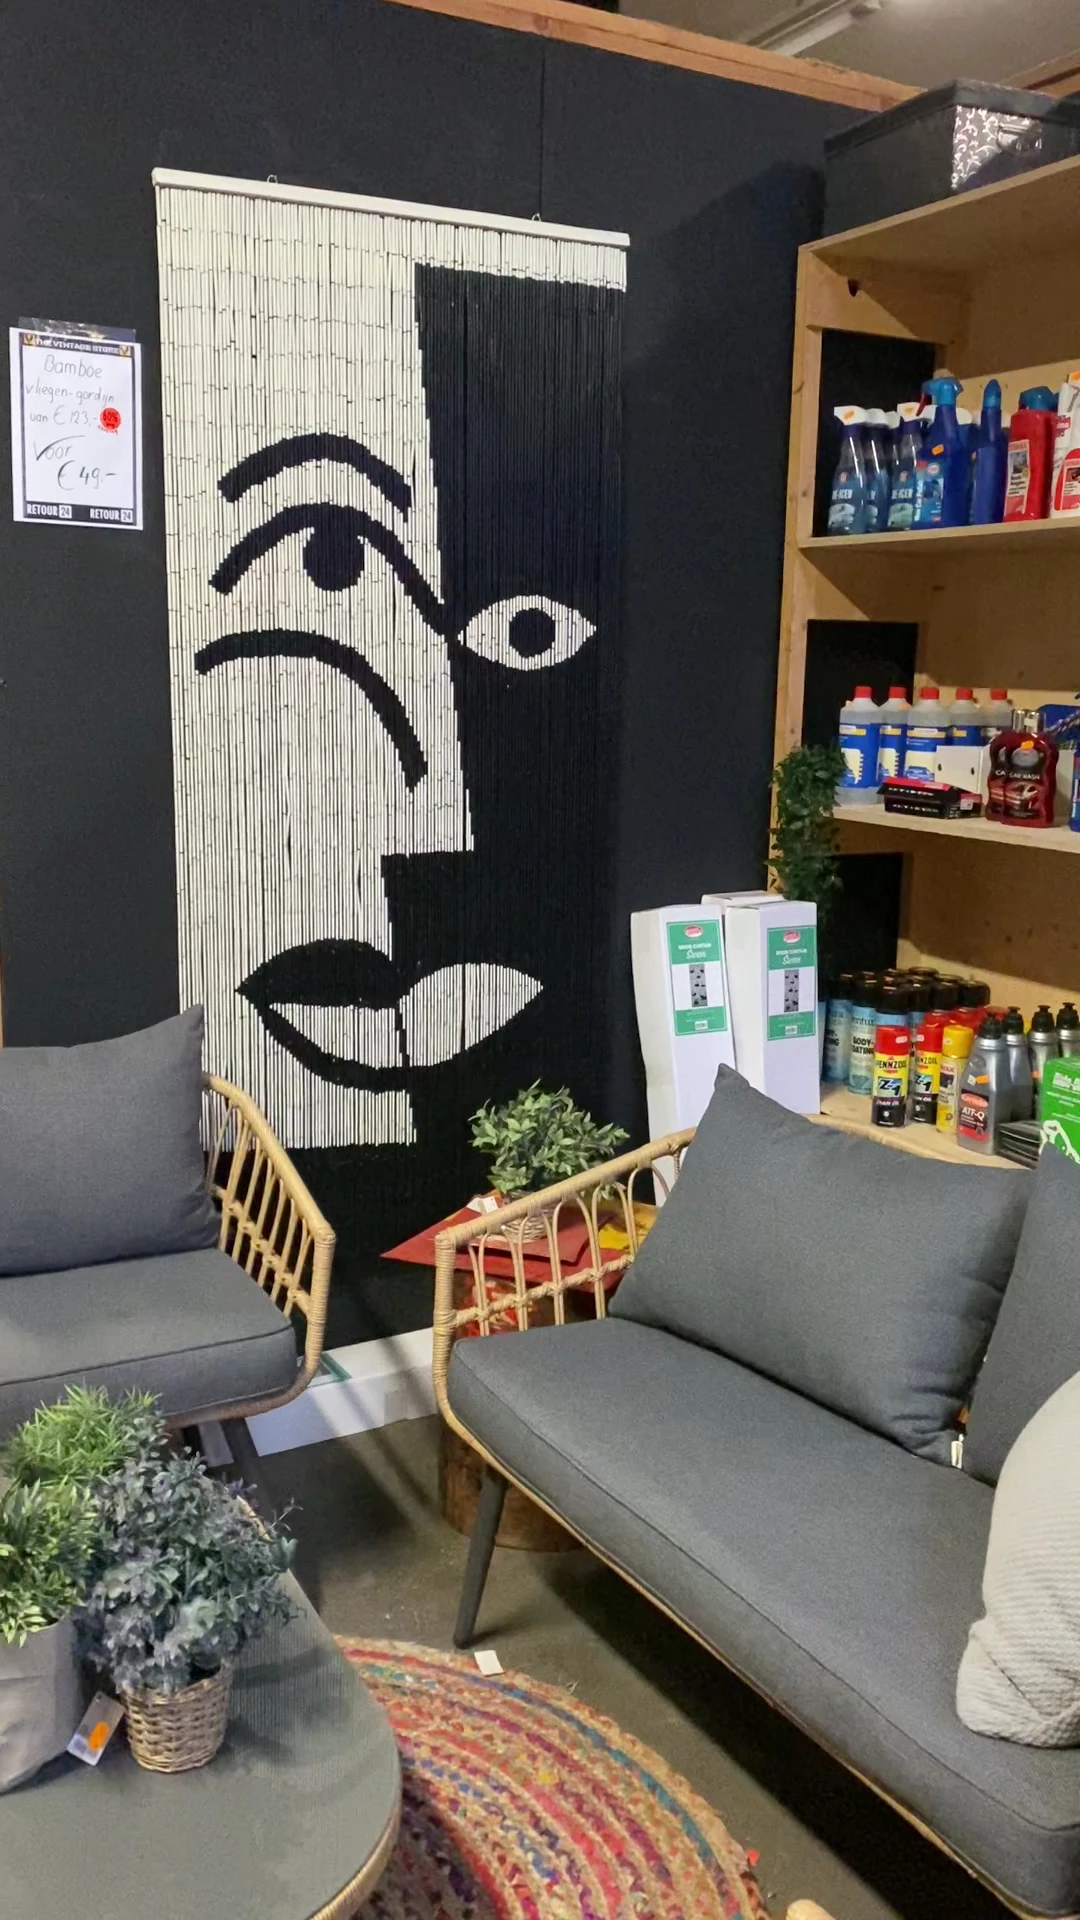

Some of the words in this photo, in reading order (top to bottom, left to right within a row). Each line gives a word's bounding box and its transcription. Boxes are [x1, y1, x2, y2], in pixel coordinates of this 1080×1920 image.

[44, 354, 103, 378] Bamboe
[30, 413, 49, 423] van
[26, 503, 59, 516] RETOUR
[61, 506, 71, 517] 24
[89, 508, 121, 520] RETOUR
[122, 510, 132, 521] 24
[961, 1106, 986, 1122] ATF-Q
